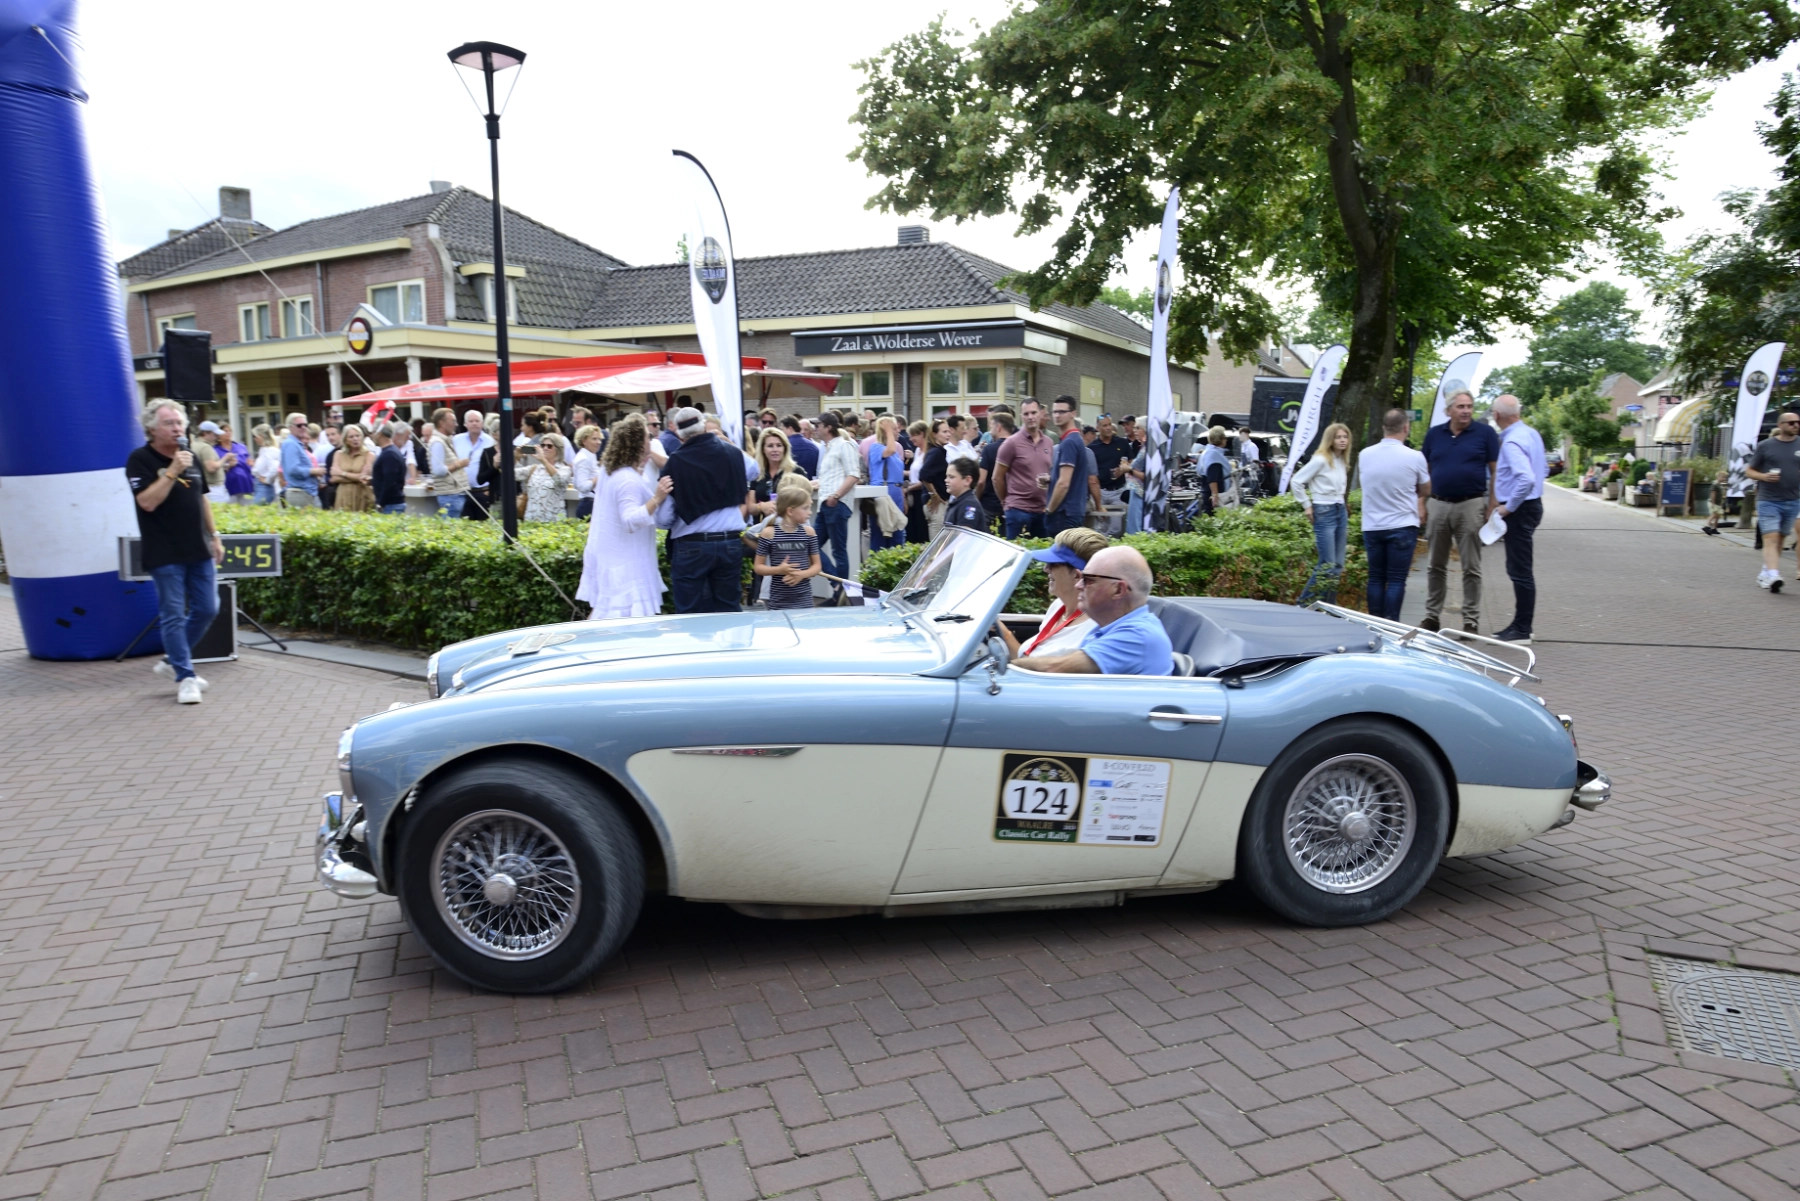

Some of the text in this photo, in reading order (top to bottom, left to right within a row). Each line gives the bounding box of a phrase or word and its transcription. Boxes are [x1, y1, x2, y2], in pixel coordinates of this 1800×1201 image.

[831, 336, 861, 351] Zaal
[872, 332, 936, 349] Wolderse
[938, 331, 983, 346] Wever
[512, 396, 552, 413] upiler
[1012, 786, 1069, 815] 124
[998, 829, 1071, 842] Classic Car Rally
